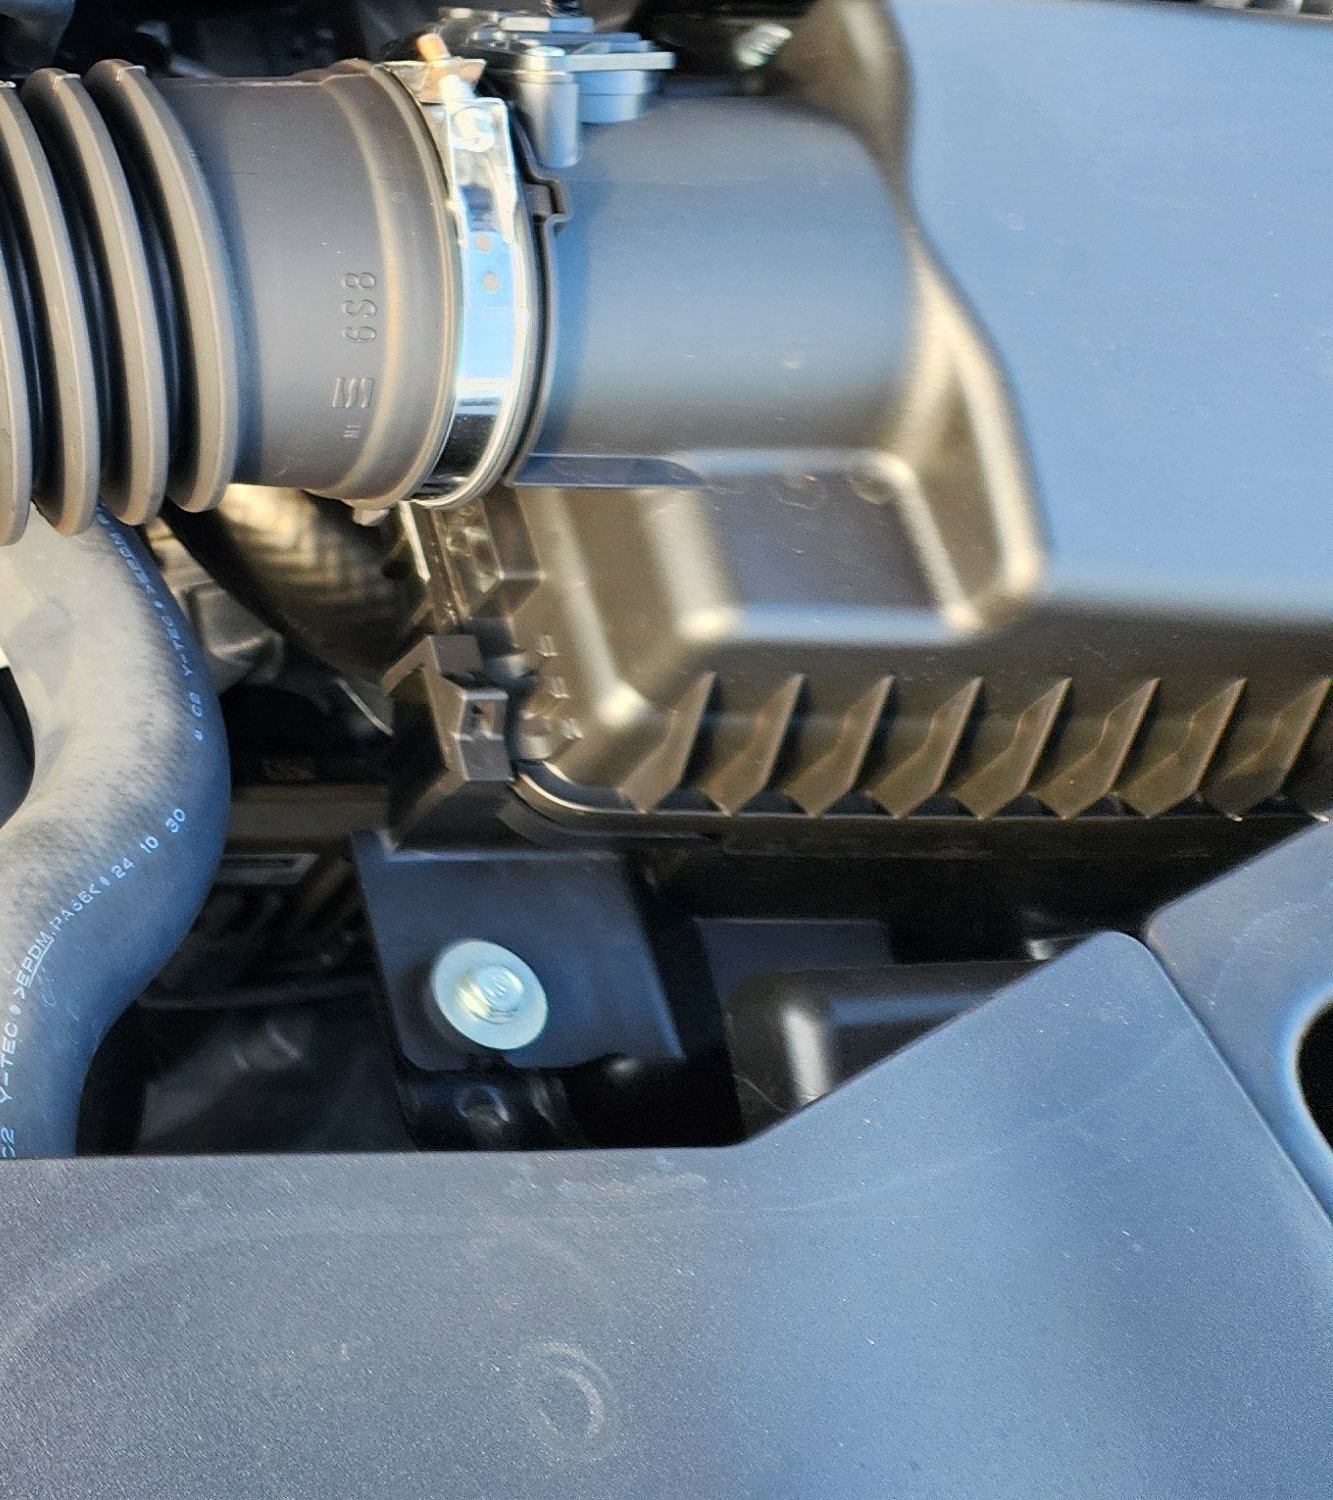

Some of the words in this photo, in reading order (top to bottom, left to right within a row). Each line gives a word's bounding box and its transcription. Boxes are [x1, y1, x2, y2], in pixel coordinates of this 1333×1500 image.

[111, 857, 136, 879] 24
[139, 835, 160, 854] 10
[165, 808, 187, 833] 30
